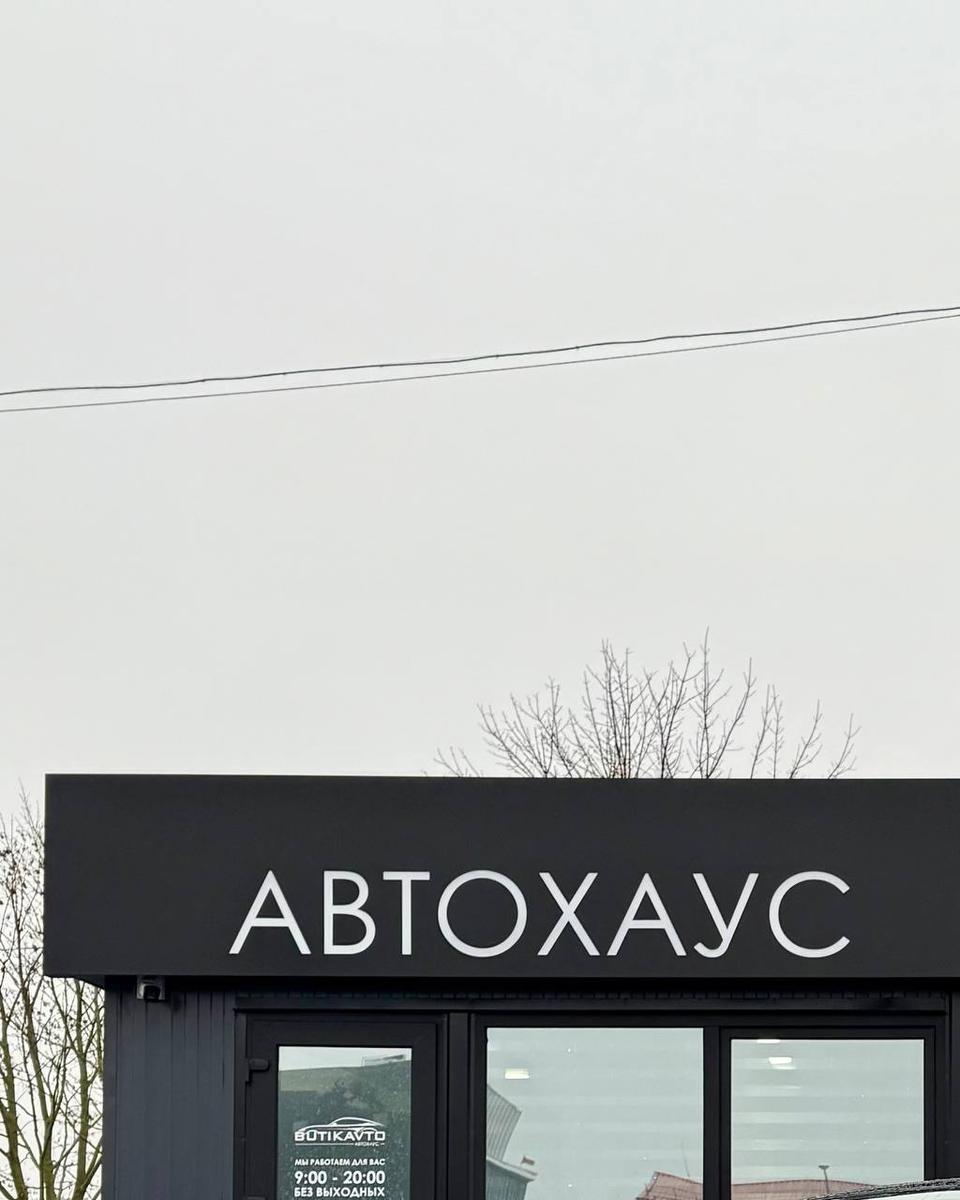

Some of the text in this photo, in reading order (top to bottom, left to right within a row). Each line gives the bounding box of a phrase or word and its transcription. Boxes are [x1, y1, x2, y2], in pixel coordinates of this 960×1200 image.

[229, 870, 850, 958] АВТОХАУС
[294, 1130, 386, 1141] BUTIKAVTO
[294, 1158, 386, 1167] МЫ РАБОТАЕМ ДЛЯ ВАС
[294, 1170, 327, 1184] 9:00
[343, 1170, 386, 1184] 20:00
[294, 1187, 385, 1198] БЕЗ ВЫХОДНЫХ
